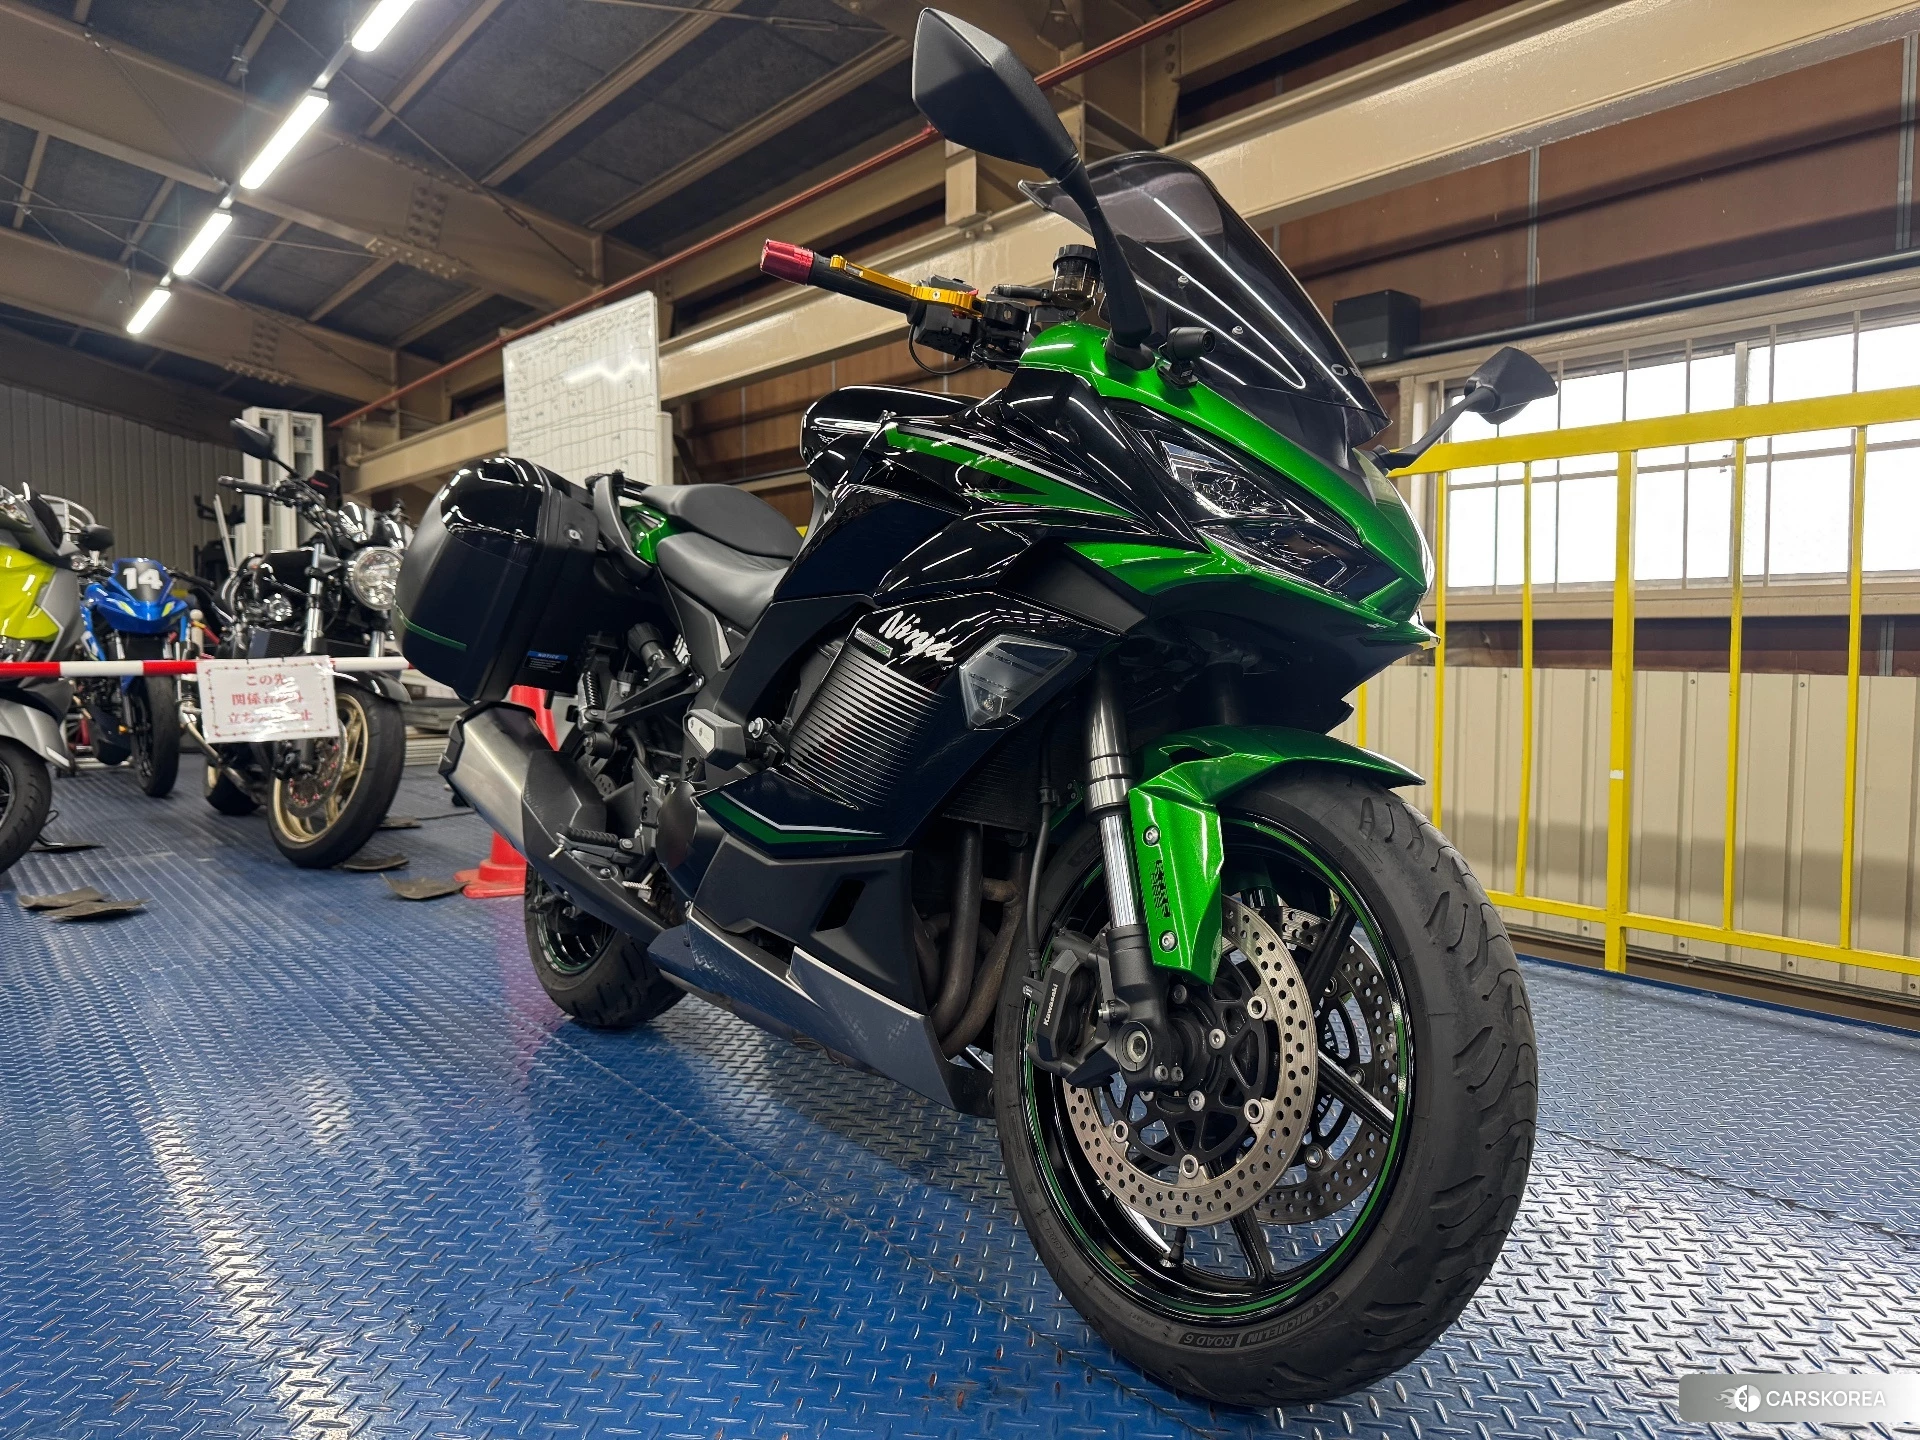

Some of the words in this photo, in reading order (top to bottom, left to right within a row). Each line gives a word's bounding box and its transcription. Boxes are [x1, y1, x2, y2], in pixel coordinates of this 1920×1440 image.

[122, 567, 164, 591] 14
[878, 610, 954, 663] Ninja
[1043, 983, 1059, 1026] Kawasaki
[1183, 1334, 1193, 1344] 6
[1196, 1335, 1235, 1347] ROAD
[1246, 1309, 1315, 1344] MICHELIN
